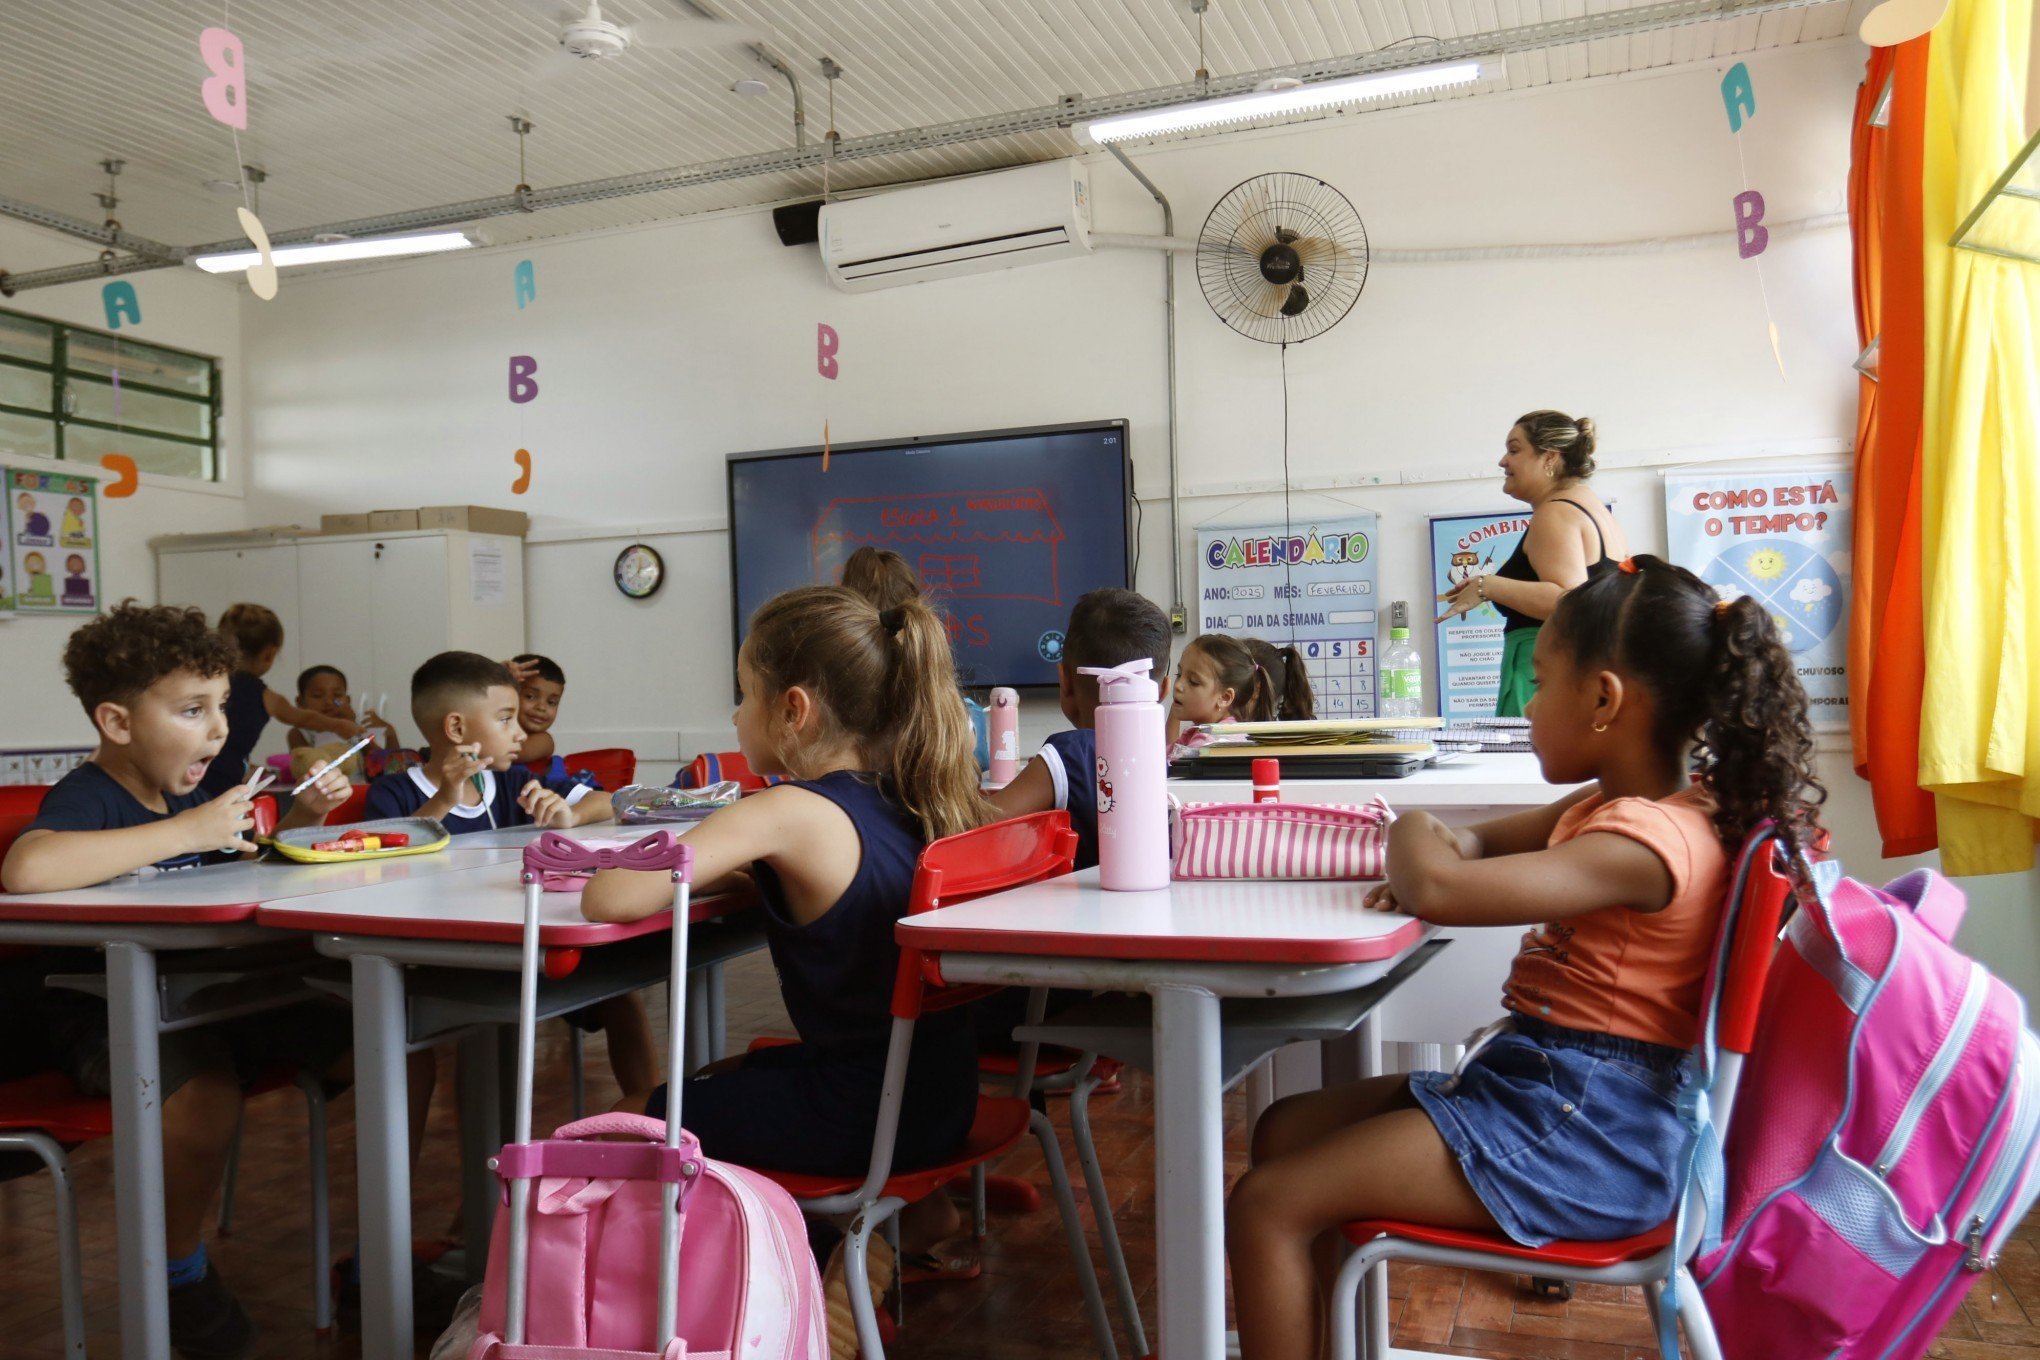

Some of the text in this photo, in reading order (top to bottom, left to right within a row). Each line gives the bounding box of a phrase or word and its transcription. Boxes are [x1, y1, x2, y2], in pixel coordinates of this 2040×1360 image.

[1721, 62, 1756, 134] A
[1733, 190, 1769, 260] B
[515, 259, 536, 310] A
[102, 281, 142, 330] A
[818, 323, 839, 380] B
[509, 355, 539, 404] B
[1103, 437, 1117, 445] 2:01
[1692, 480, 1839, 512] COMO ESTÁ
[1457, 519, 1531, 550] COMBIN
[1704, 511, 1828, 537] O TEMPO?
[1206, 526, 1370, 570] CALENDÁRIO
[1203, 582, 1366, 600] ANO: 2025 MÊS: FEVEREIRO
[1205, 612, 1325, 629] DIA: DIA DA SEMANA
[1307, 641, 1367, 657] Q S S
[1359, 662, 1366, 672] 1
[1797, 666, 1845, 676] CHUVOSO
[1360, 680, 1367, 691] 8
[1356, 699, 1369, 711] 15
